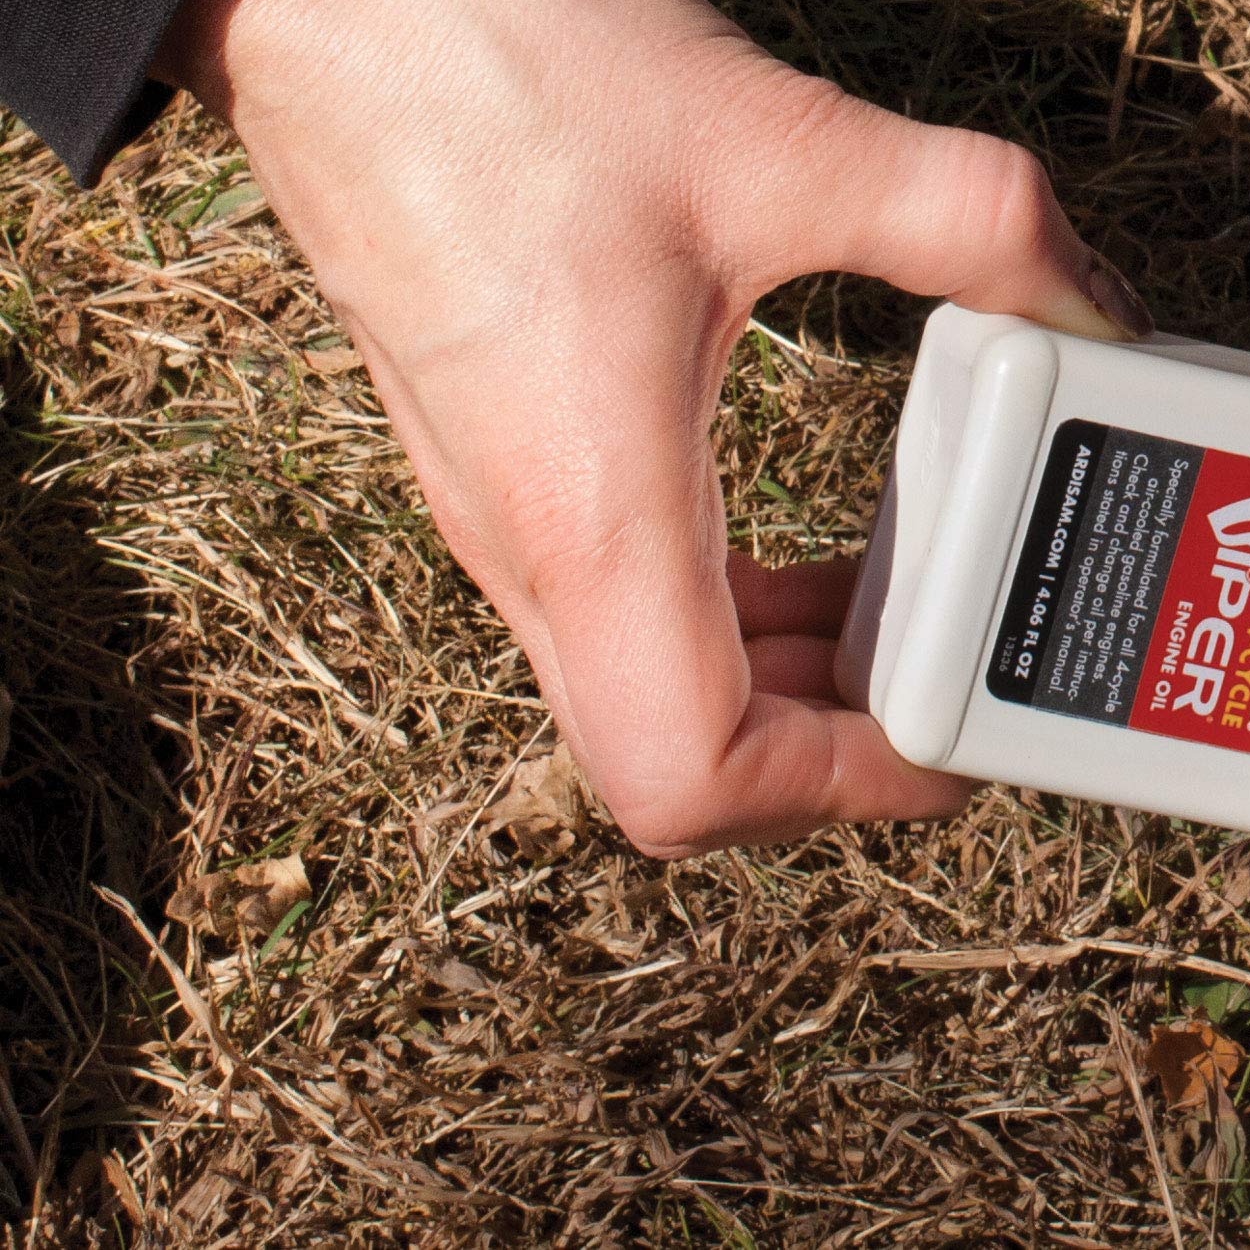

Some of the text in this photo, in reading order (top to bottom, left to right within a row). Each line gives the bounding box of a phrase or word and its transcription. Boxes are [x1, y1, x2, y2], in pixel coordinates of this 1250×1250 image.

[1107, 450, 1128, 485] tions
[1046, 444, 1092, 569] ARDISAM.COM
[1093, 489, 1115, 535] stated
[1088, 538, 1104, 552] in
[1067, 454, 1149, 702] Check and change oil per instruc-
[1092, 478, 1160, 684] air-cooled gasoline engines.
[1105, 459, 1190, 714] Specially formulated for all 4-cycle
[1029, 587, 1051, 626] 4.06
[999, 637, 1017, 673] 13236
[1023, 630, 1040, 648] FL
[1150, 601, 1194, 711] ENGINE OIL
[1015, 652, 1033, 679] OZ
[1048, 635, 1073, 694] manual.
